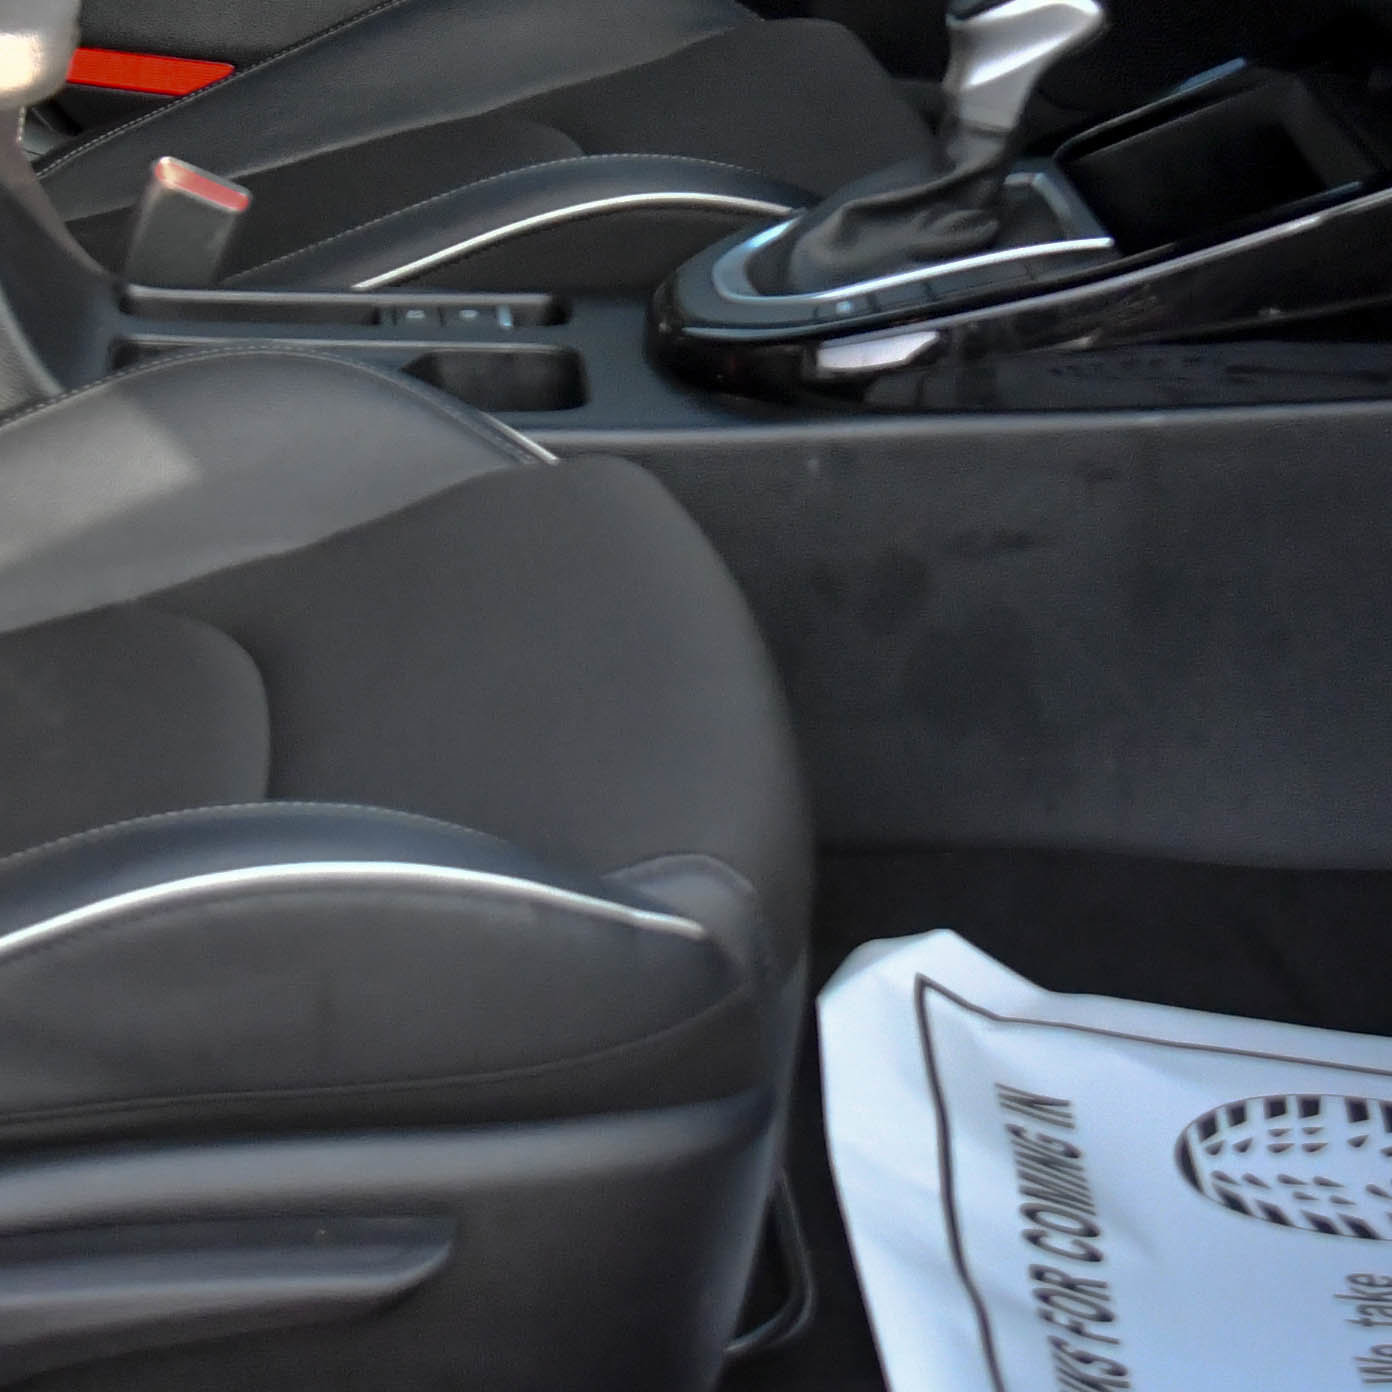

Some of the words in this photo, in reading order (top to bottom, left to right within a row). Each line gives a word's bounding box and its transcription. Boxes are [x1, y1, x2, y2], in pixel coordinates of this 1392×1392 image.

[993, 1082, 1077, 1131] IN
[1002, 1123, 1107, 1266] COMING
[1026, 1263, 1122, 1346] FOR
